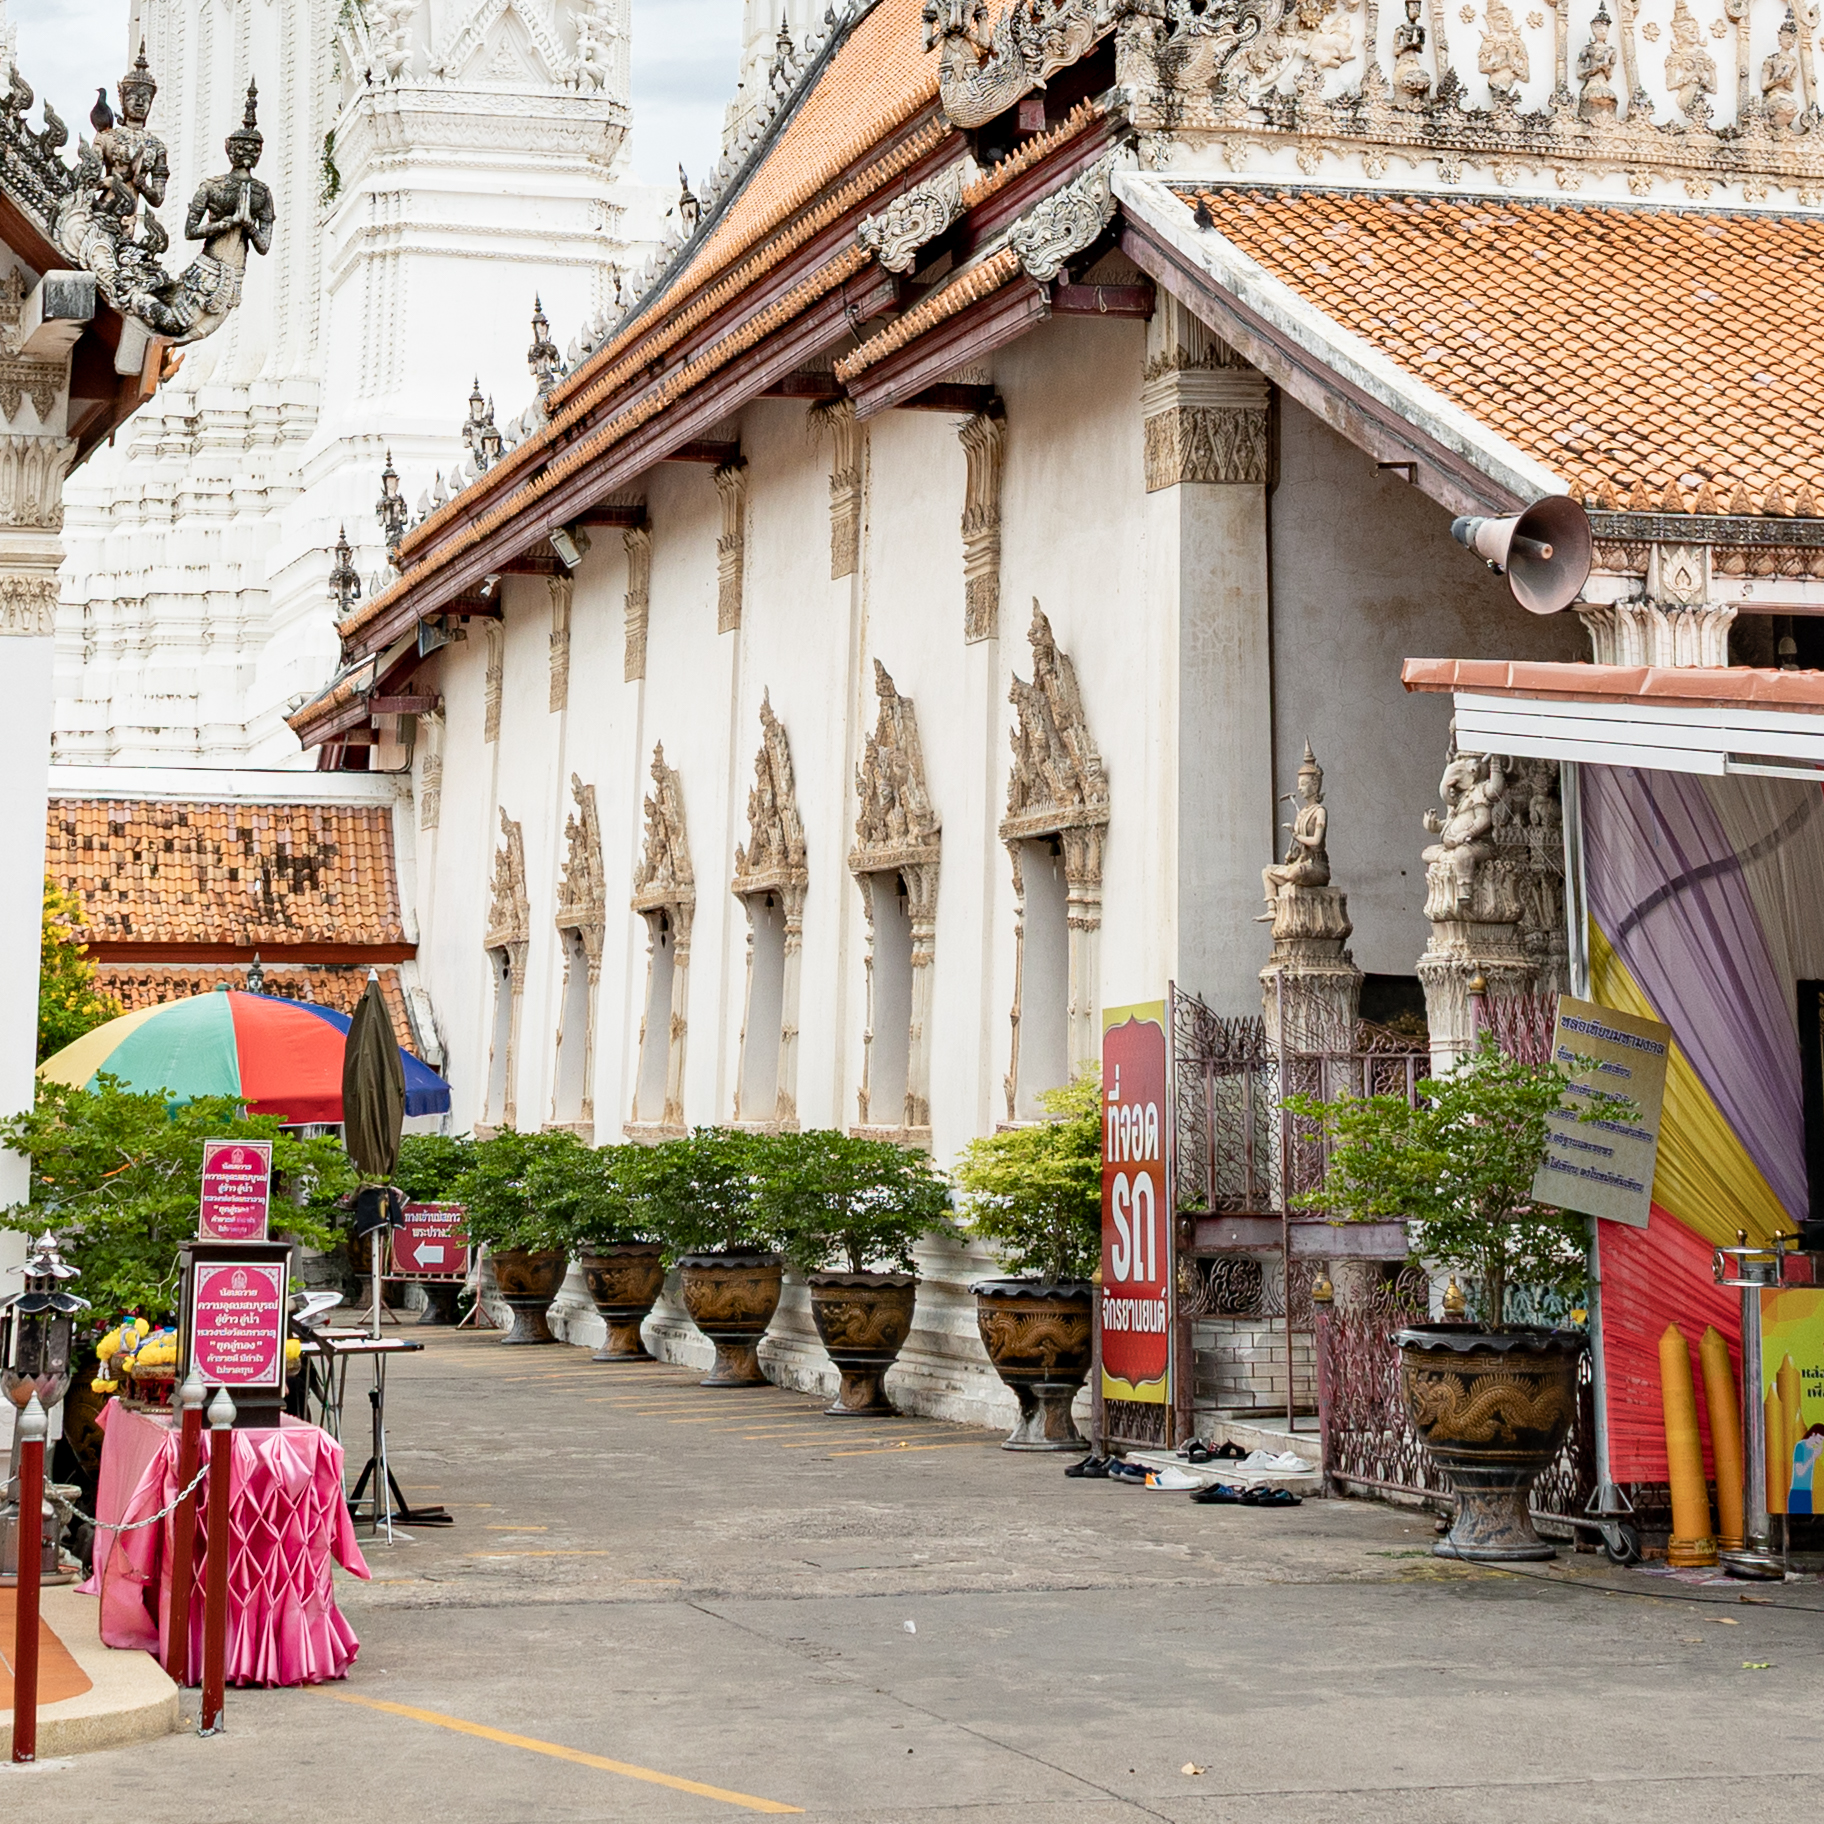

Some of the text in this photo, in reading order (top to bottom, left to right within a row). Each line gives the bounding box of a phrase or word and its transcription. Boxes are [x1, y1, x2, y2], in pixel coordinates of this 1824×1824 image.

[1560, 1014, 1666, 1056] หล่อเทียนมหามงคล
[1106, 1064, 1159, 1162] ที่จอด
[1111, 1170, 1156, 1284] รถ
[1102, 1286, 1167, 1334] จักรยานยนต์
